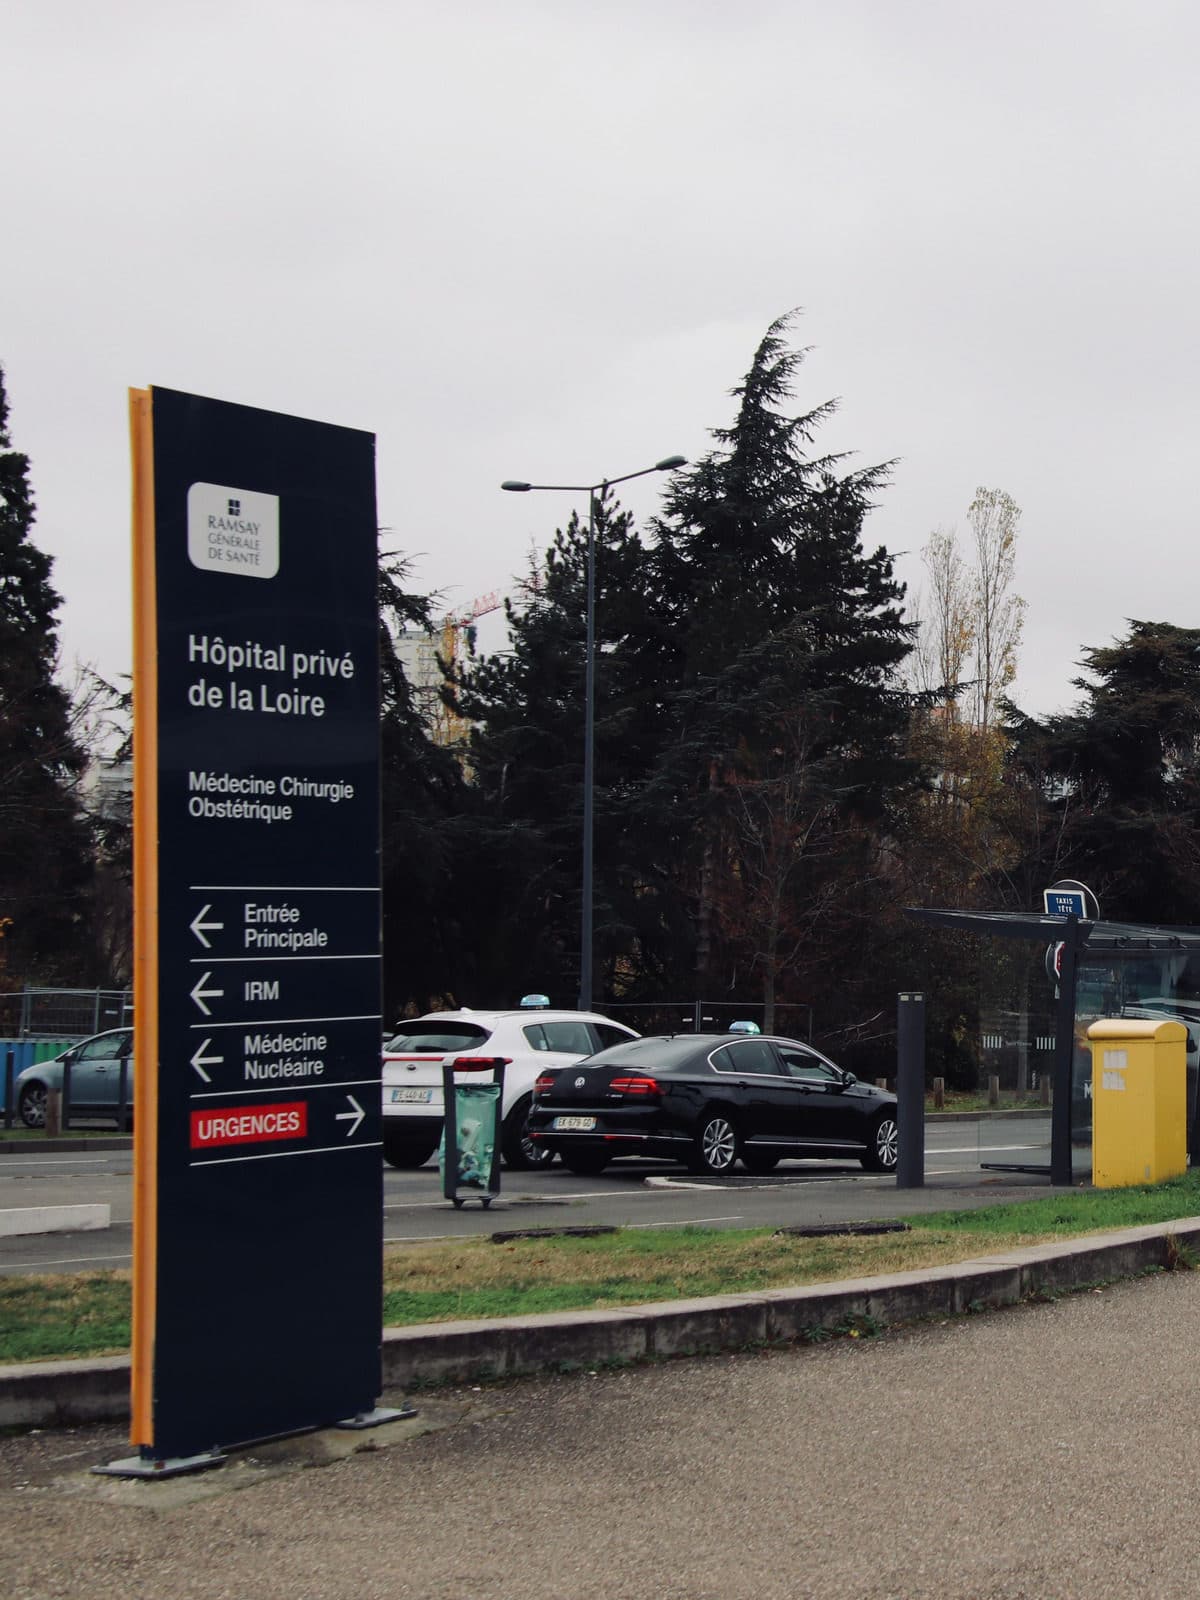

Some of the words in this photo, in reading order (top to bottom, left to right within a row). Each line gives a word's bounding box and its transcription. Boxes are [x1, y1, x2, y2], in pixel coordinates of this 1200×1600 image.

[208, 515, 261, 536] RAMSAY
[208, 531, 262, 551] GÉNÉRALE
[208, 547, 223, 561] DE
[225, 550, 262, 566] SANTÉ
[188, 634, 286, 673] Hôpital
[292, 649, 355, 679] privé
[188, 678, 223, 708] de
[230, 681, 254, 711] la
[260, 684, 326, 717] Loire
[189, 771, 276, 797] Médecine
[279, 776, 355, 805] Chirurgie
[188, 796, 293, 824] Obstétrique
[1055, 897, 1074, 905] TAXIS
[1057, 904, 1073, 913] TÊTE
[245, 903, 301, 924] Entrée
[245, 928, 328, 952] Principale
[245, 981, 280, 1001] IRM
[245, 1032, 327, 1056] Médecine
[245, 1057, 324, 1081] Nucléaire
[197, 1111, 301, 1141] URGENCES
